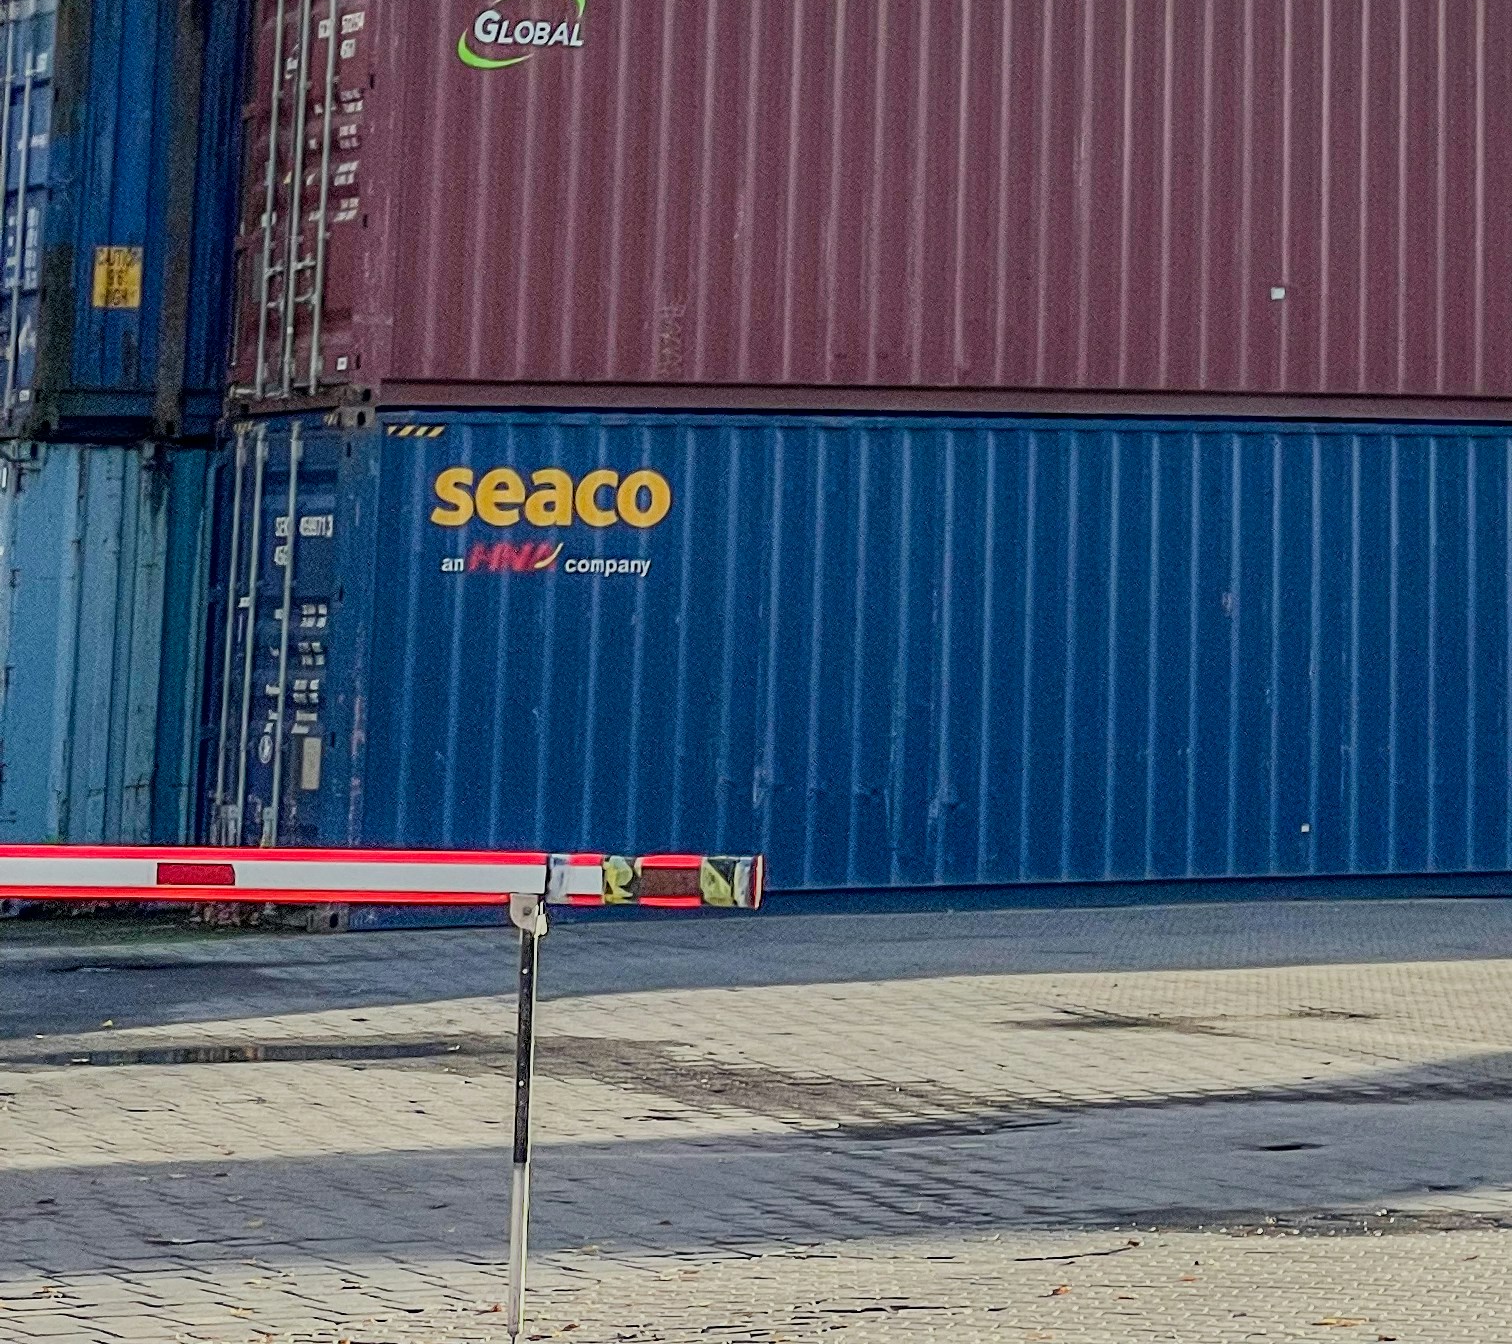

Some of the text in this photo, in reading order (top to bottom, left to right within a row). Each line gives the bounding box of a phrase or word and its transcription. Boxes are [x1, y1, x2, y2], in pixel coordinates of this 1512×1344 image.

[474, 9, 584, 47] GLOBAL
[431, 467, 671, 528] seaco
[441, 558, 464, 572] an
[565, 558, 651, 577] company
